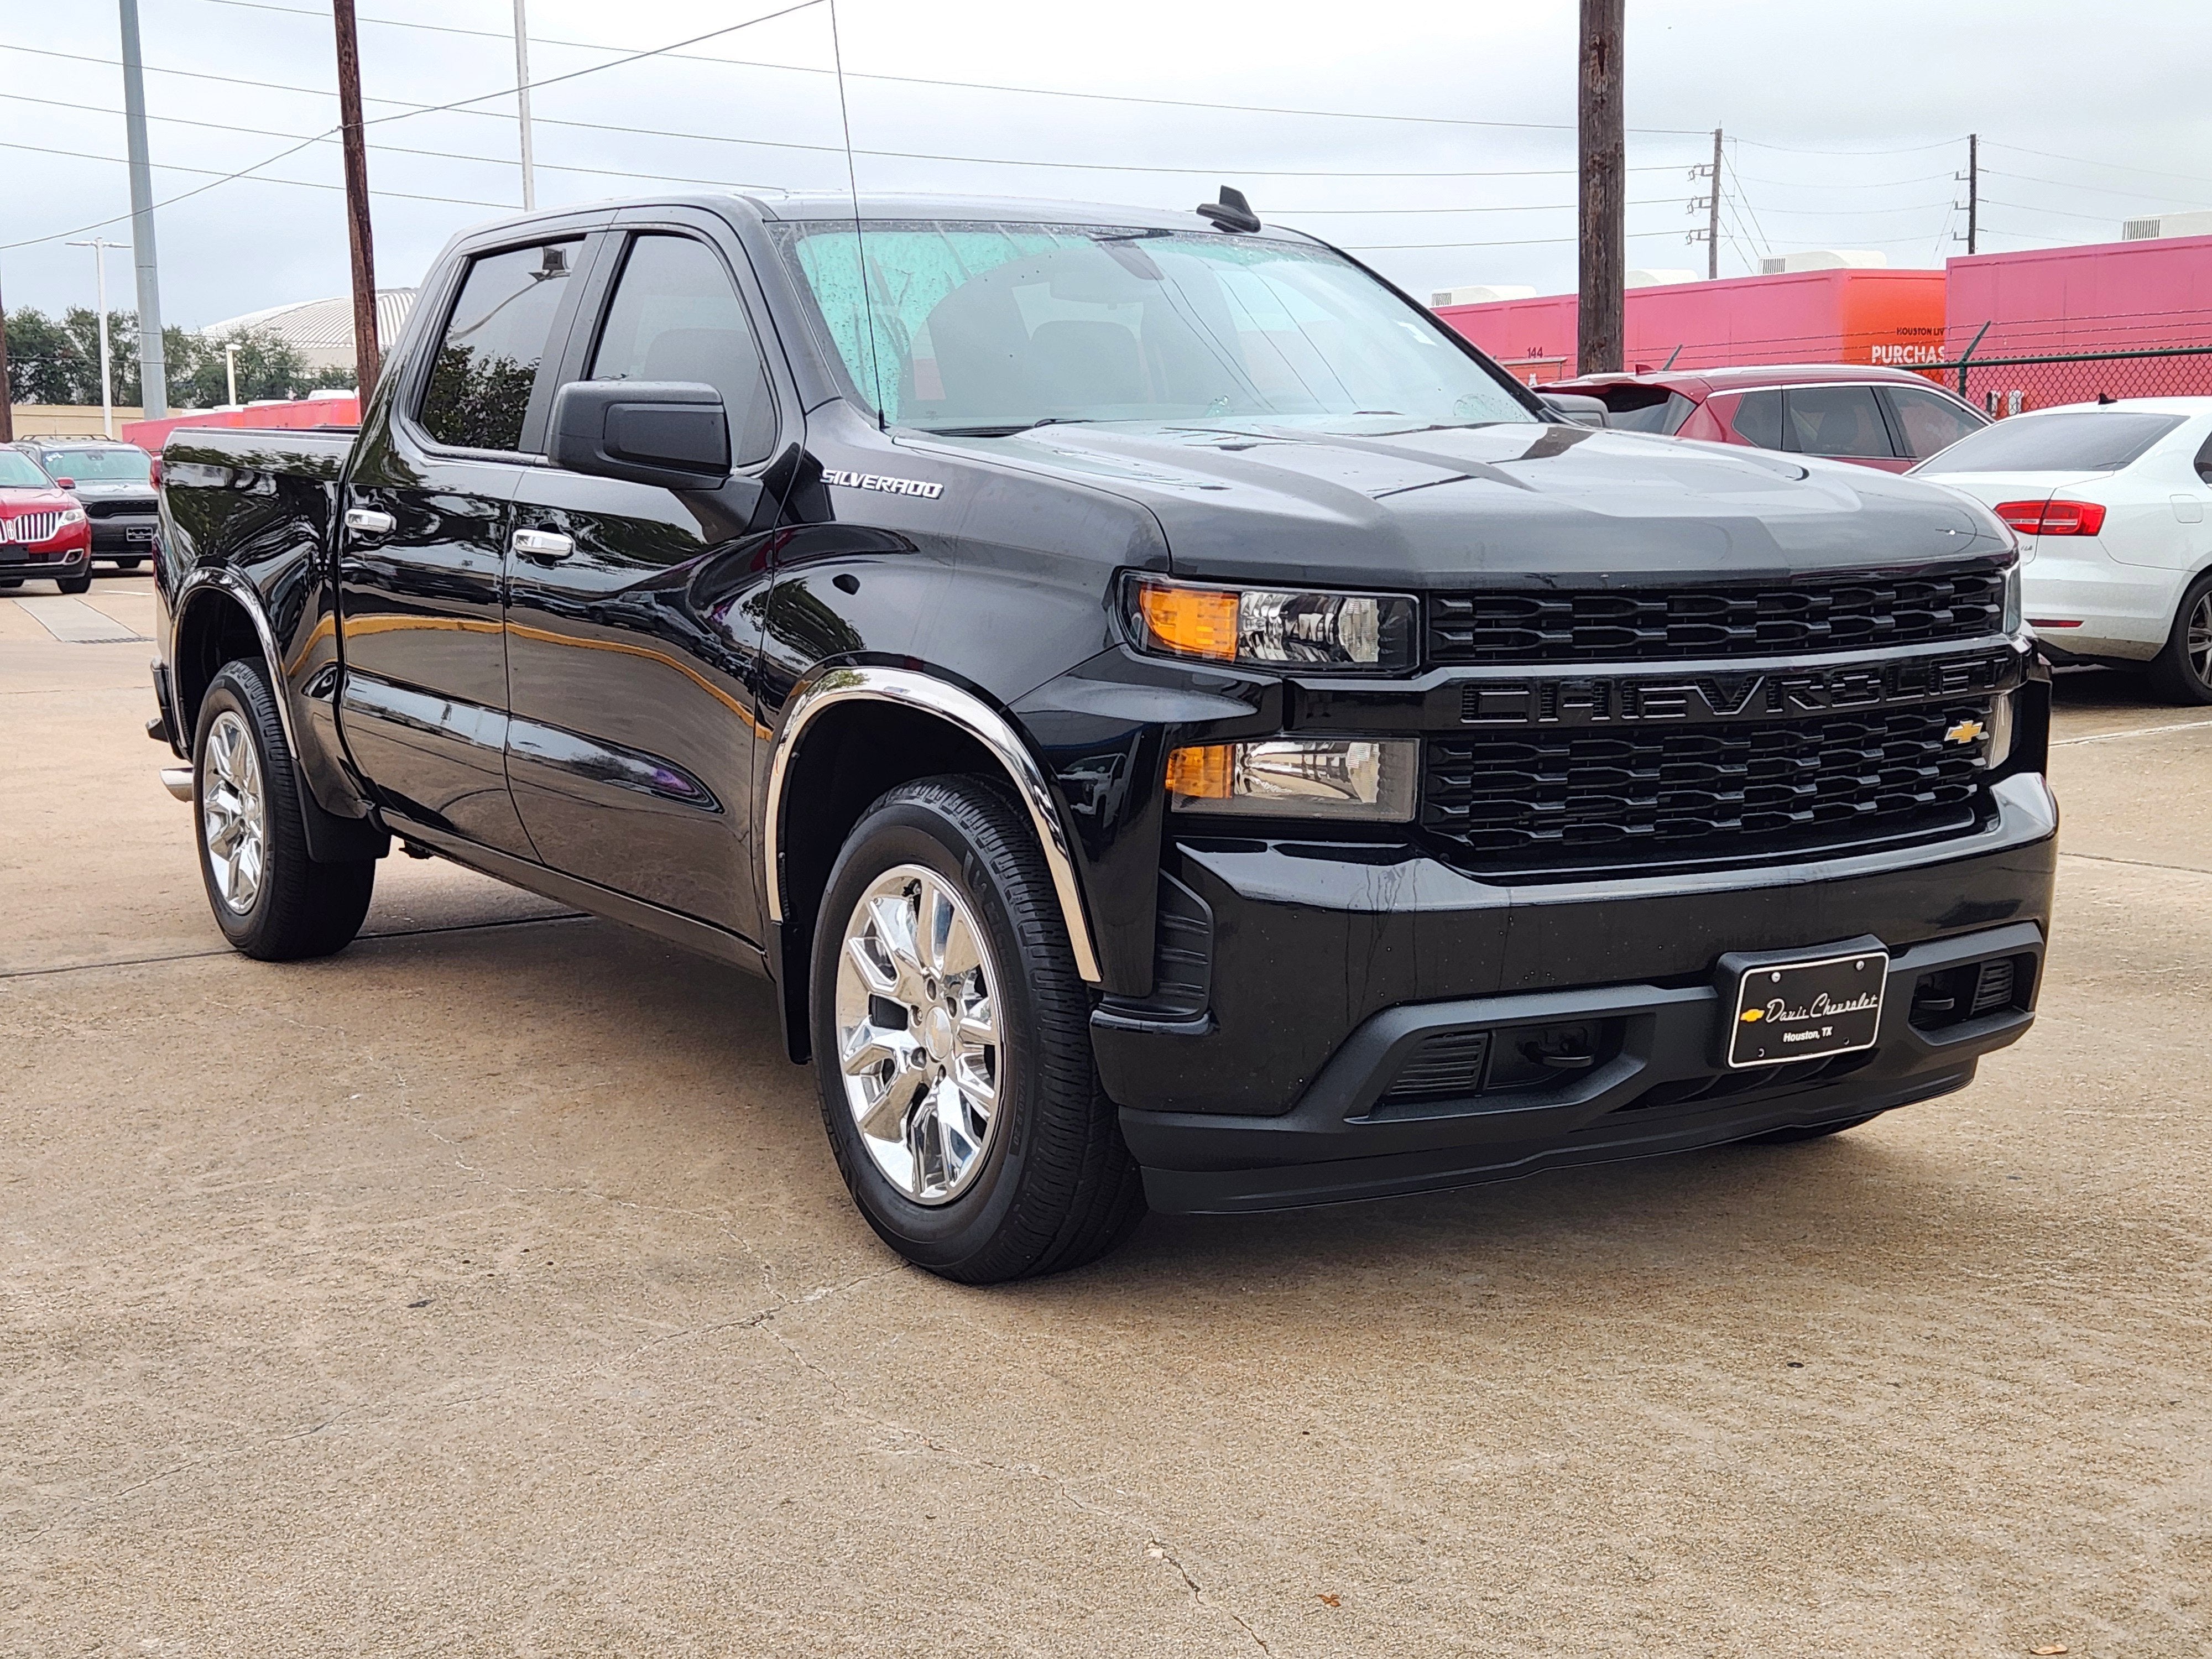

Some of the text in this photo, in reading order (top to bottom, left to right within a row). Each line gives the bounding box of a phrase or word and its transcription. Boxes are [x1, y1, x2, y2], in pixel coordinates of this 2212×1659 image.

[1896, 327, 1932, 336] HOUSTON
[1527, 346, 1543, 358] 144
[820, 469, 944, 499] SILVERADO
[1460, 651, 2010, 723] CHEVROLET
[1765, 992, 1878, 1023] Davis Chevrolet
[1783, 1026, 1833, 1042] Houston, TX
